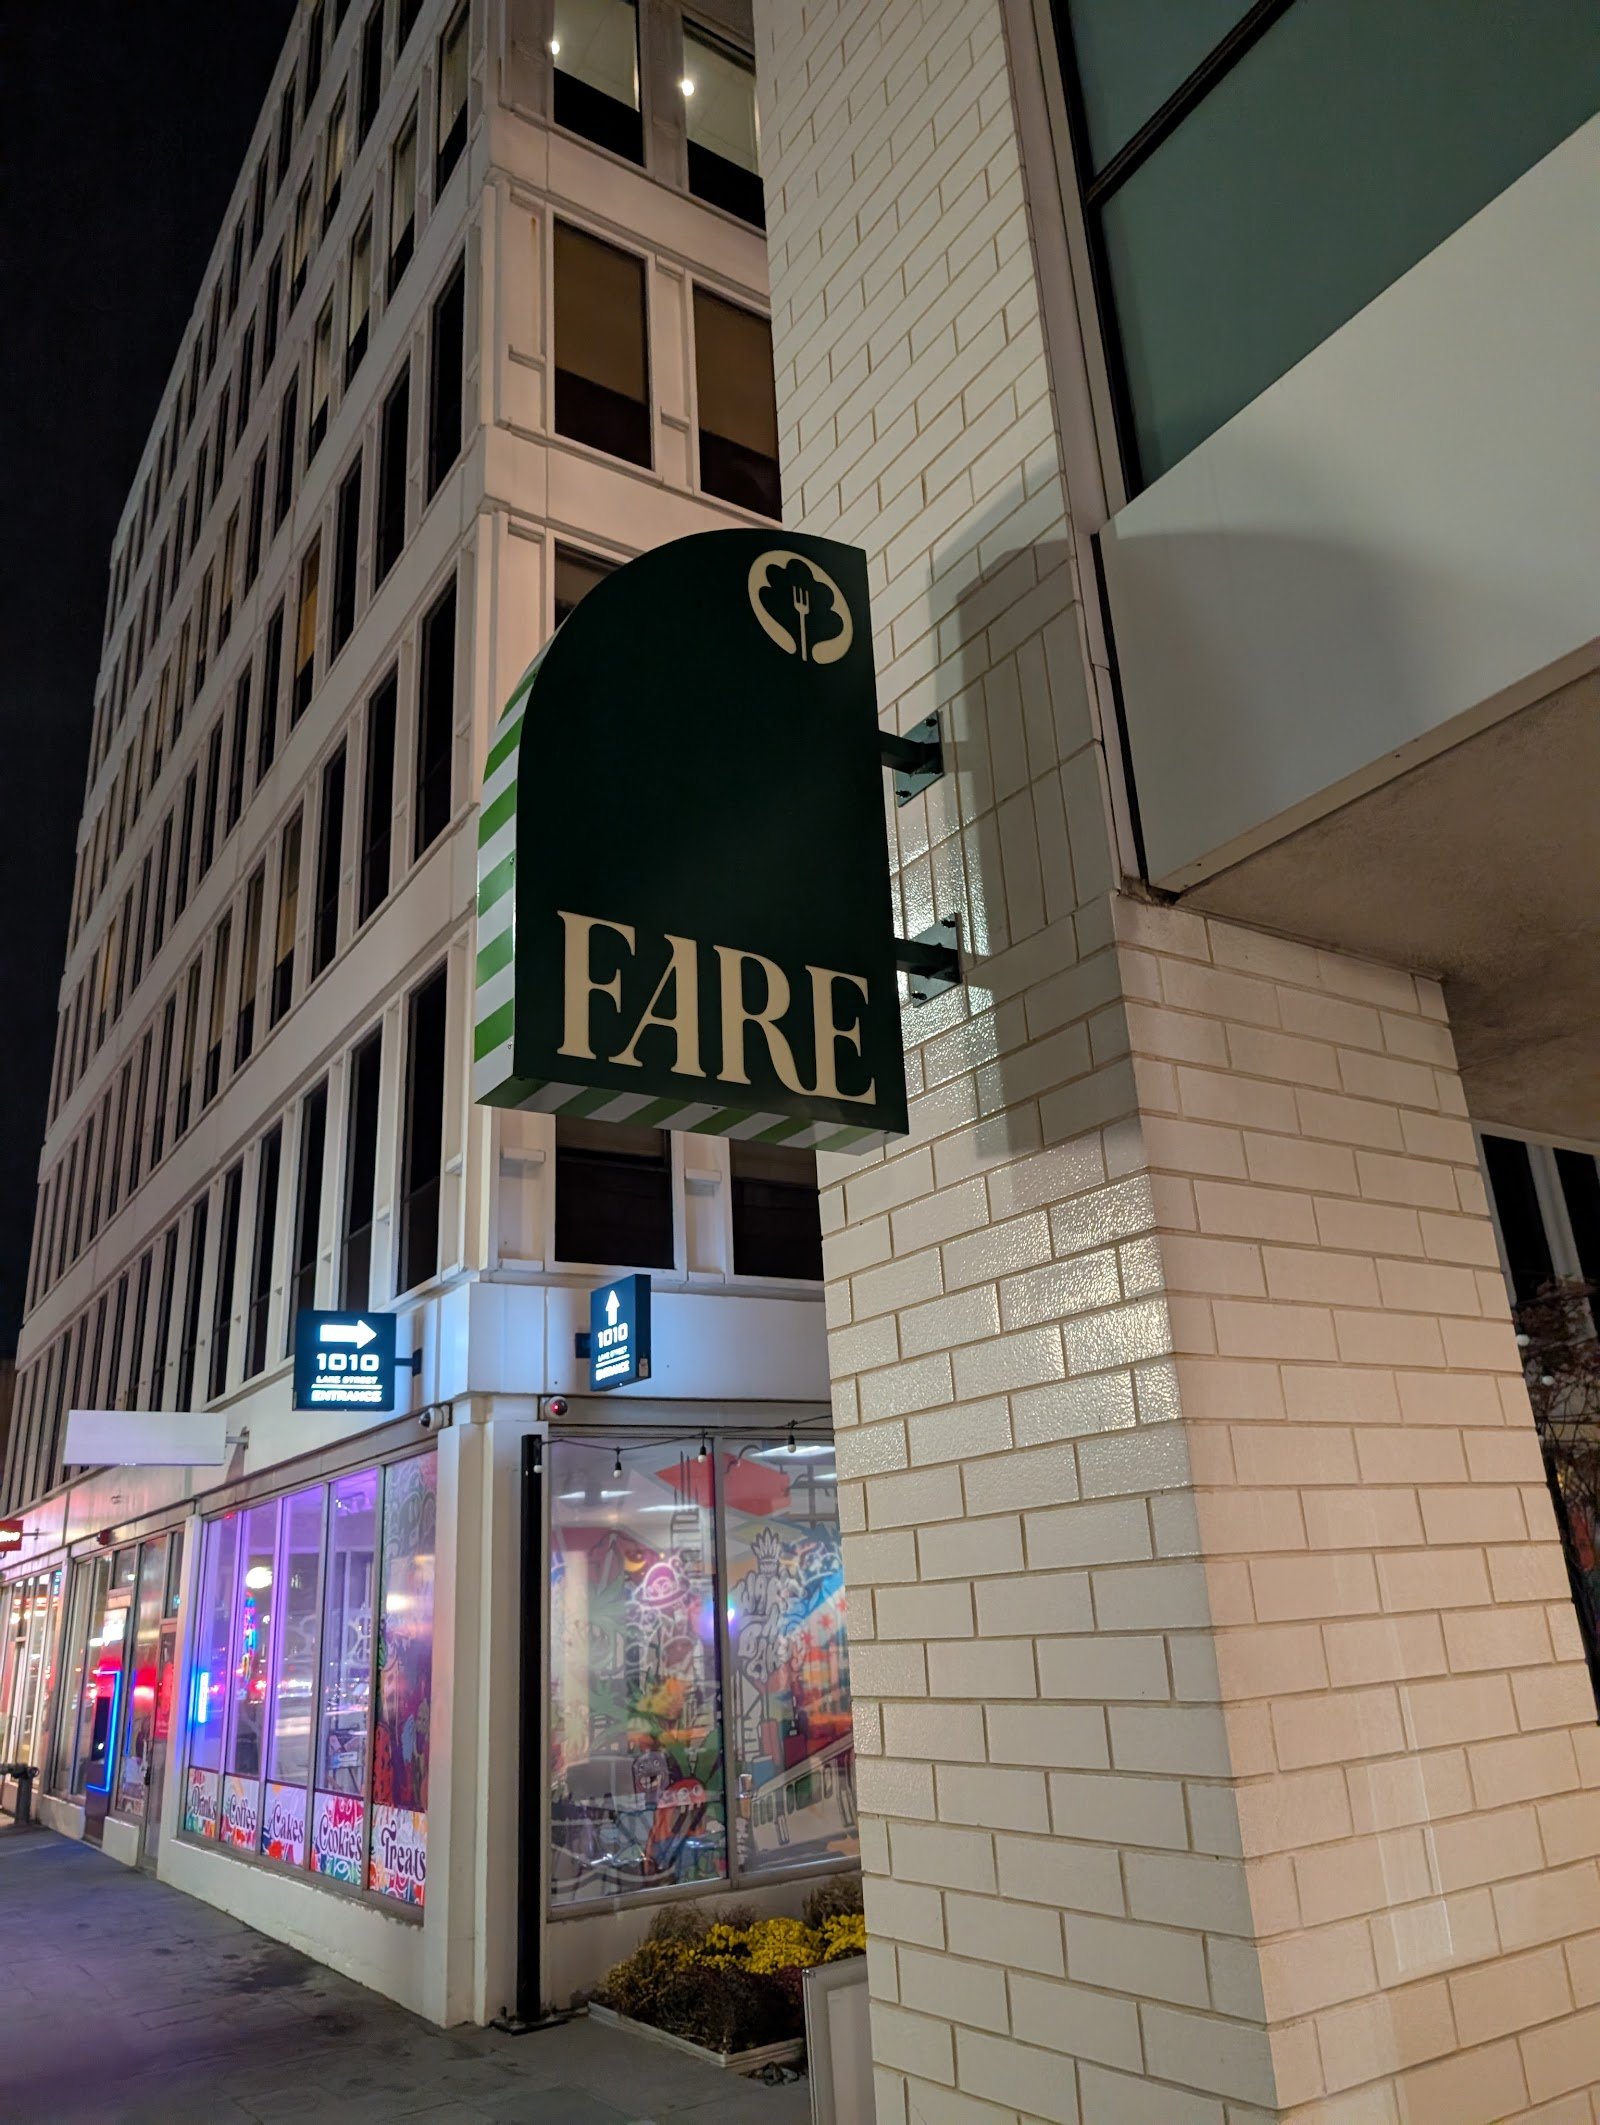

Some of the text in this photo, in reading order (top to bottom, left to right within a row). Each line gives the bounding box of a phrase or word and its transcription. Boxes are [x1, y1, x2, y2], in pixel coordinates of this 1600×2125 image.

[557, 910, 876, 1105] FARE
[597, 1322, 628, 1348] 1010
[315, 1375, 378, 1385] LAKE STREET
[316, 1353, 379, 1371] 1010
[311, 1389, 382, 1402] ENTRANCE
[229, 1793, 257, 1831] Coffee
[273, 1803, 304, 1844] Cakes
[318, 1813, 362, 1862] Cookies
[381, 1820, 427, 1882] Treats
